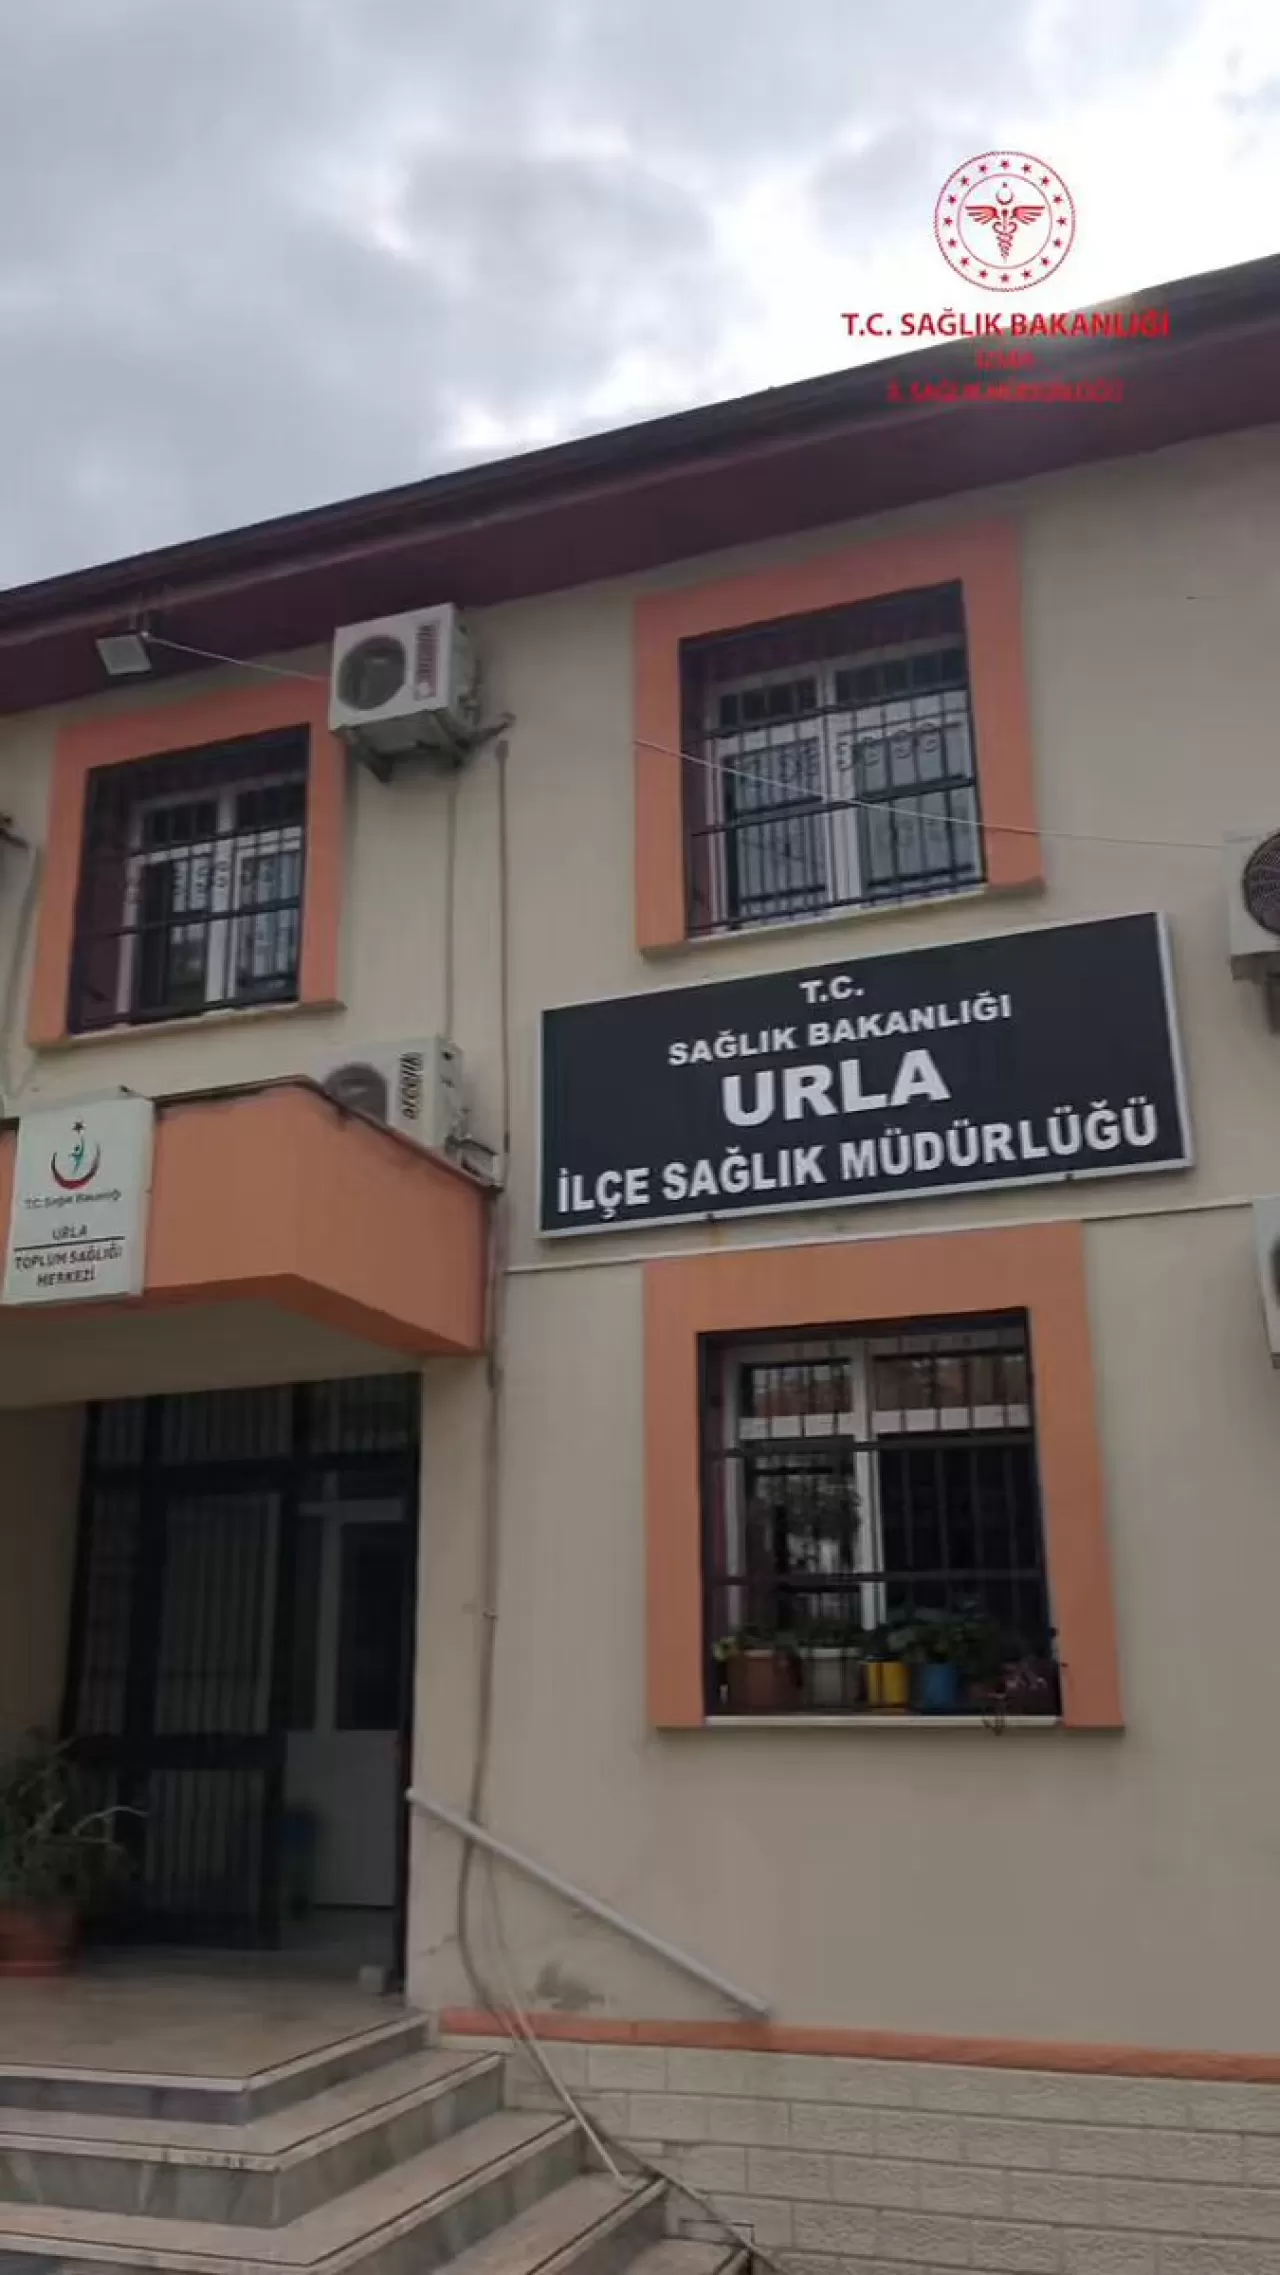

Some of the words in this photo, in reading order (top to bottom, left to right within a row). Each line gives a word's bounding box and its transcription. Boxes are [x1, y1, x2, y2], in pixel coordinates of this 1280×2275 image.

[800, 976, 864, 1003] T.C.
[668, 1029, 799, 1067] SAĞLIK
[807, 991, 1012, 1047] BAKANLIĞI
[722, 1049, 951, 1127] URLA
[557, 1167, 650, 1219] İLÇE
[663, 1146, 827, 1195] SAĞLIK
[842, 1097, 1158, 1181] MÜDÜRLÜĞÜ
[52, 1224, 88, 1240] URLA
[15, 1251, 67, 1270] TOPLUM
